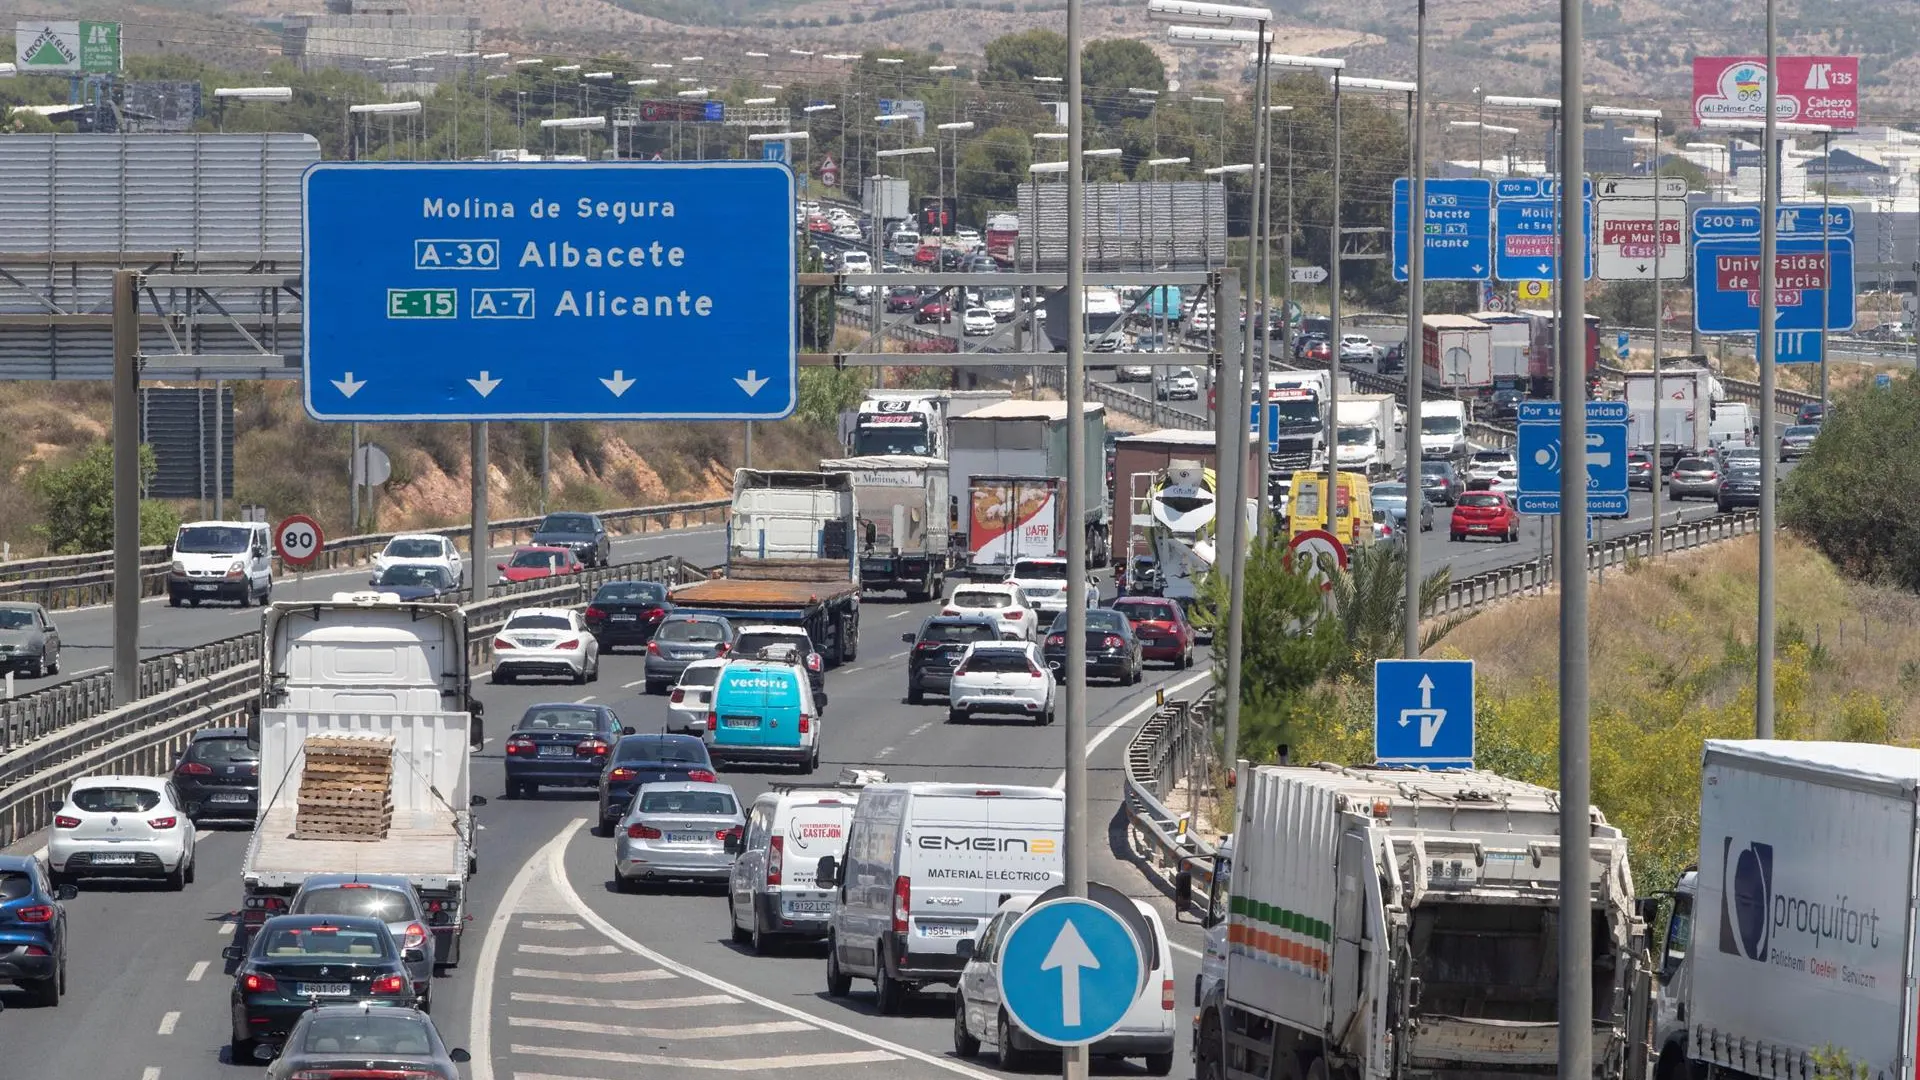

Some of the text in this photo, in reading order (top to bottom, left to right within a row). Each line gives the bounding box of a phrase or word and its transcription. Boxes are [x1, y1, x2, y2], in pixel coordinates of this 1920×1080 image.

[21, 26, 77, 62] LEROY MERLIN
[1831, 73, 1852, 84] 135
[1808, 96, 1852, 107] Cabezo
[1805, 108, 1855, 119] Cortado
[1503, 184, 1520, 192] 700
[424, 197, 675, 224] Molina de Segura
[1425, 209, 1470, 219] lbacete
[1518, 222, 1529, 230] de
[1606, 222, 1679, 231] Universdad
[1702, 216, 1753, 228] 200 m
[1426, 238, 1470, 248] licante
[1612, 234, 1626, 244] de
[420, 241, 686, 268] A-30 Albacete
[1729, 274, 1820, 288] de urcia
[391, 290, 714, 316] E-15 A-7 Alicante
[1523, 407, 1541, 416] Por
[1525, 500, 1558, 508] Control
[286, 532, 312, 548] 80
[730, 678, 788, 690] vectoris
[928, 868, 1050, 881] MATERIAL ELÉCTRICO
[1772, 893, 1880, 950] proquifort
[928, 926, 968, 936] 3584 LJH
